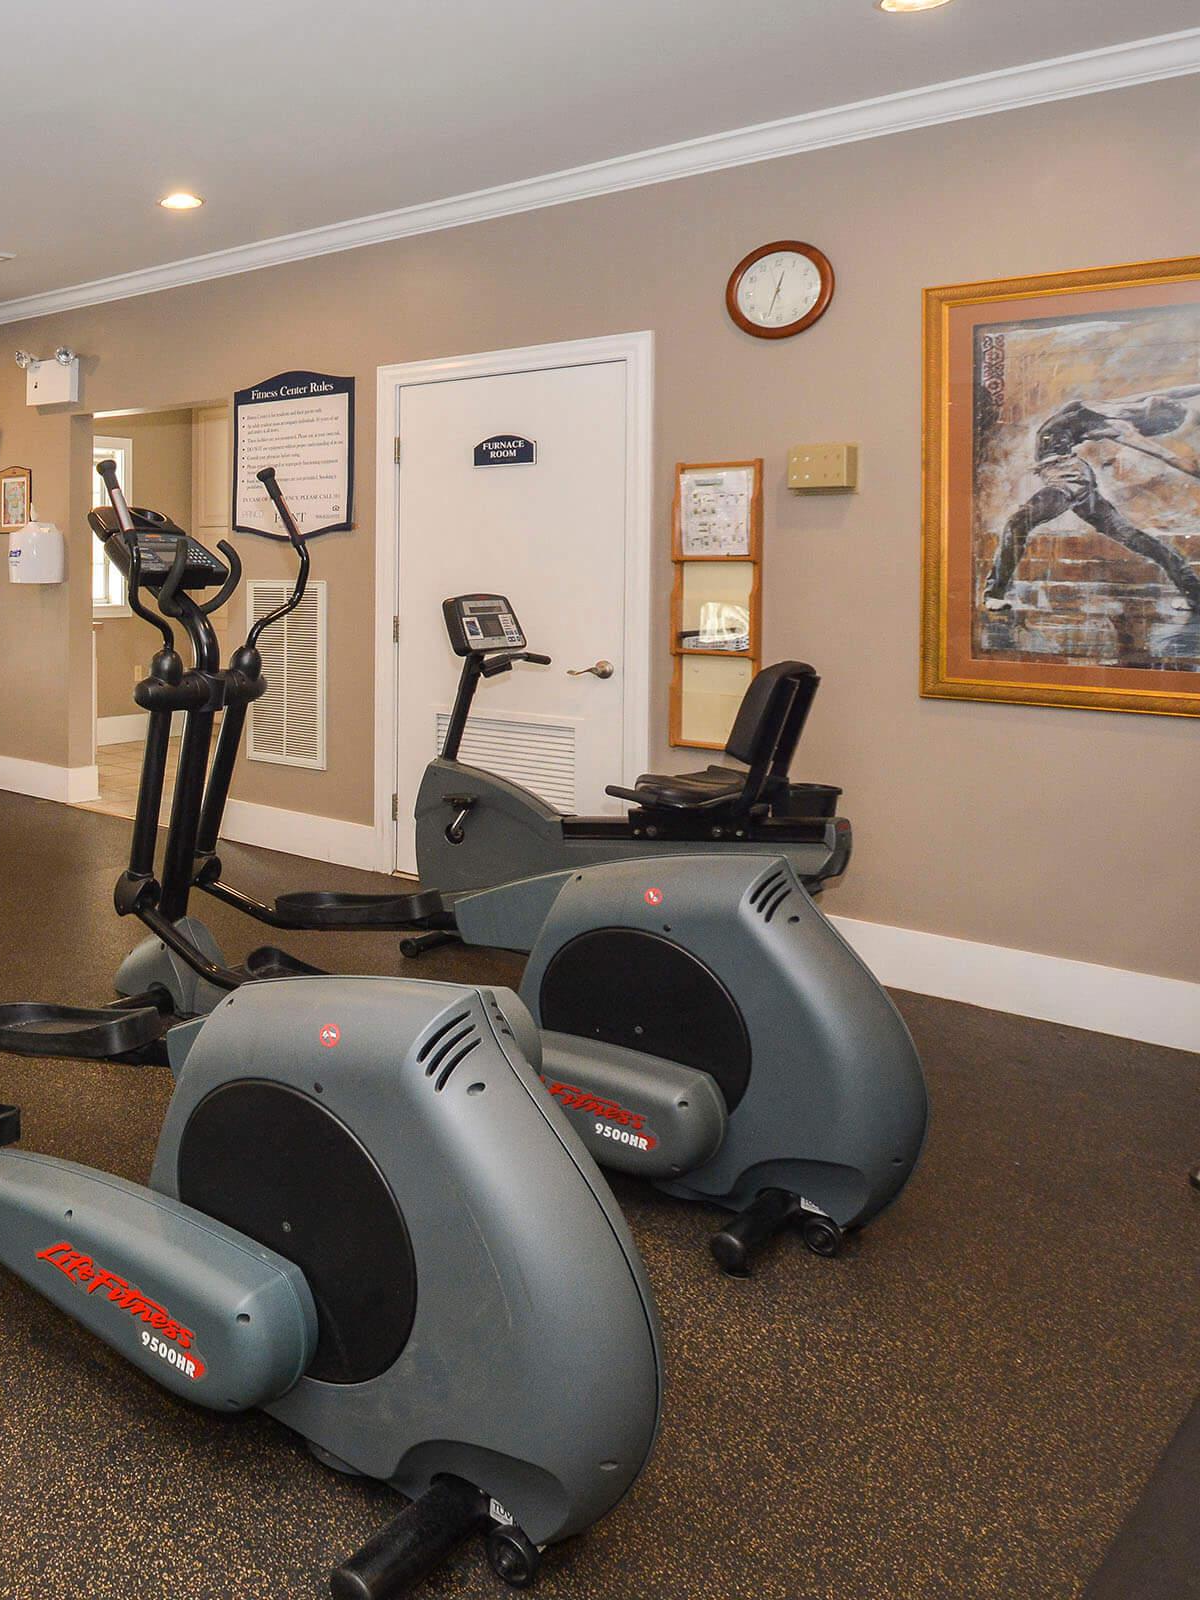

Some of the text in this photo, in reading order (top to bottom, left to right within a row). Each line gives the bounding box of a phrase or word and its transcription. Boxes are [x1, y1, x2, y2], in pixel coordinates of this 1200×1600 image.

[251, 381, 334, 400] Fitness Center Rules
[482, 440, 525, 459] FURNACE ROOM
[547, 1082, 648, 1130] Fitness
[595, 1122, 649, 1151] 9500HR
[141, 1330, 197, 1379] 9500HR
